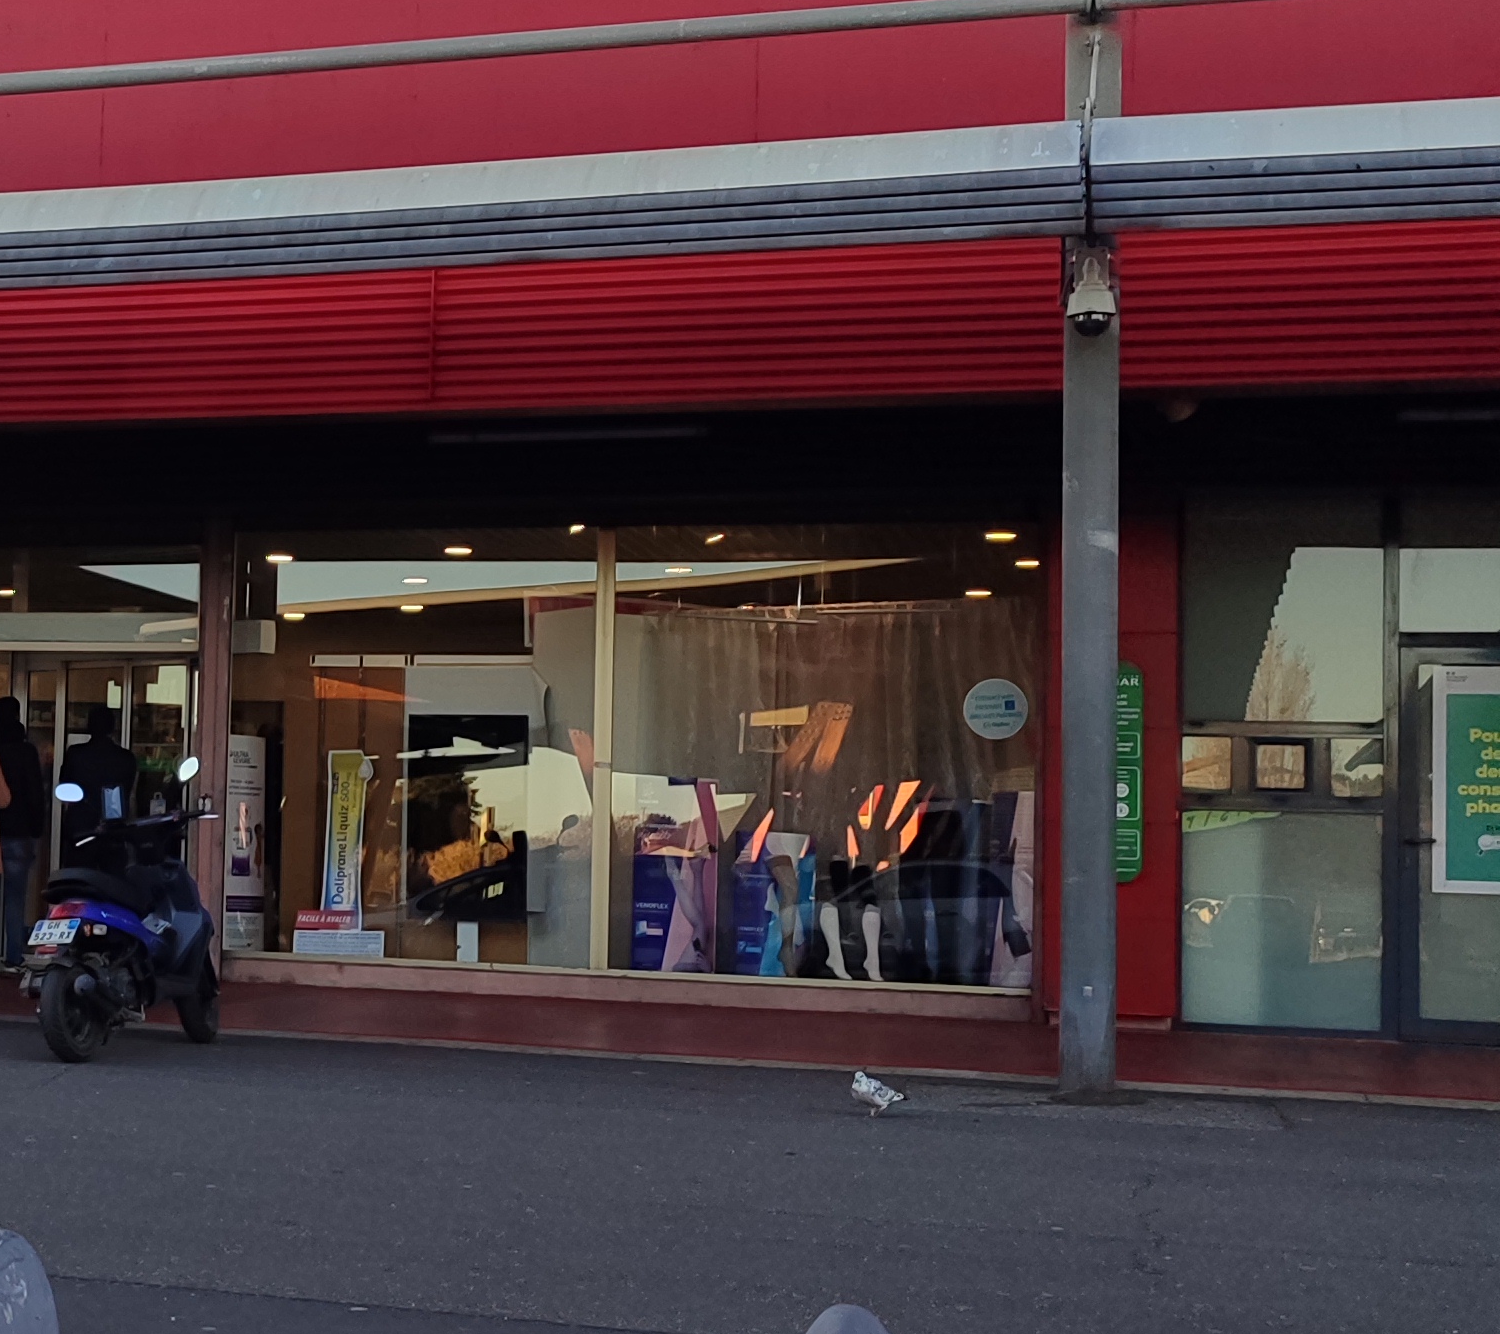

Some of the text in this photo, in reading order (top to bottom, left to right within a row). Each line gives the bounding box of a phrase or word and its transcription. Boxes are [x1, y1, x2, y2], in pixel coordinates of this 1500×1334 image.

[1117, 677, 1139, 686] AR
[635, 902, 669, 910] VENOFLEX
[297, 914, 319, 923] FACILE
